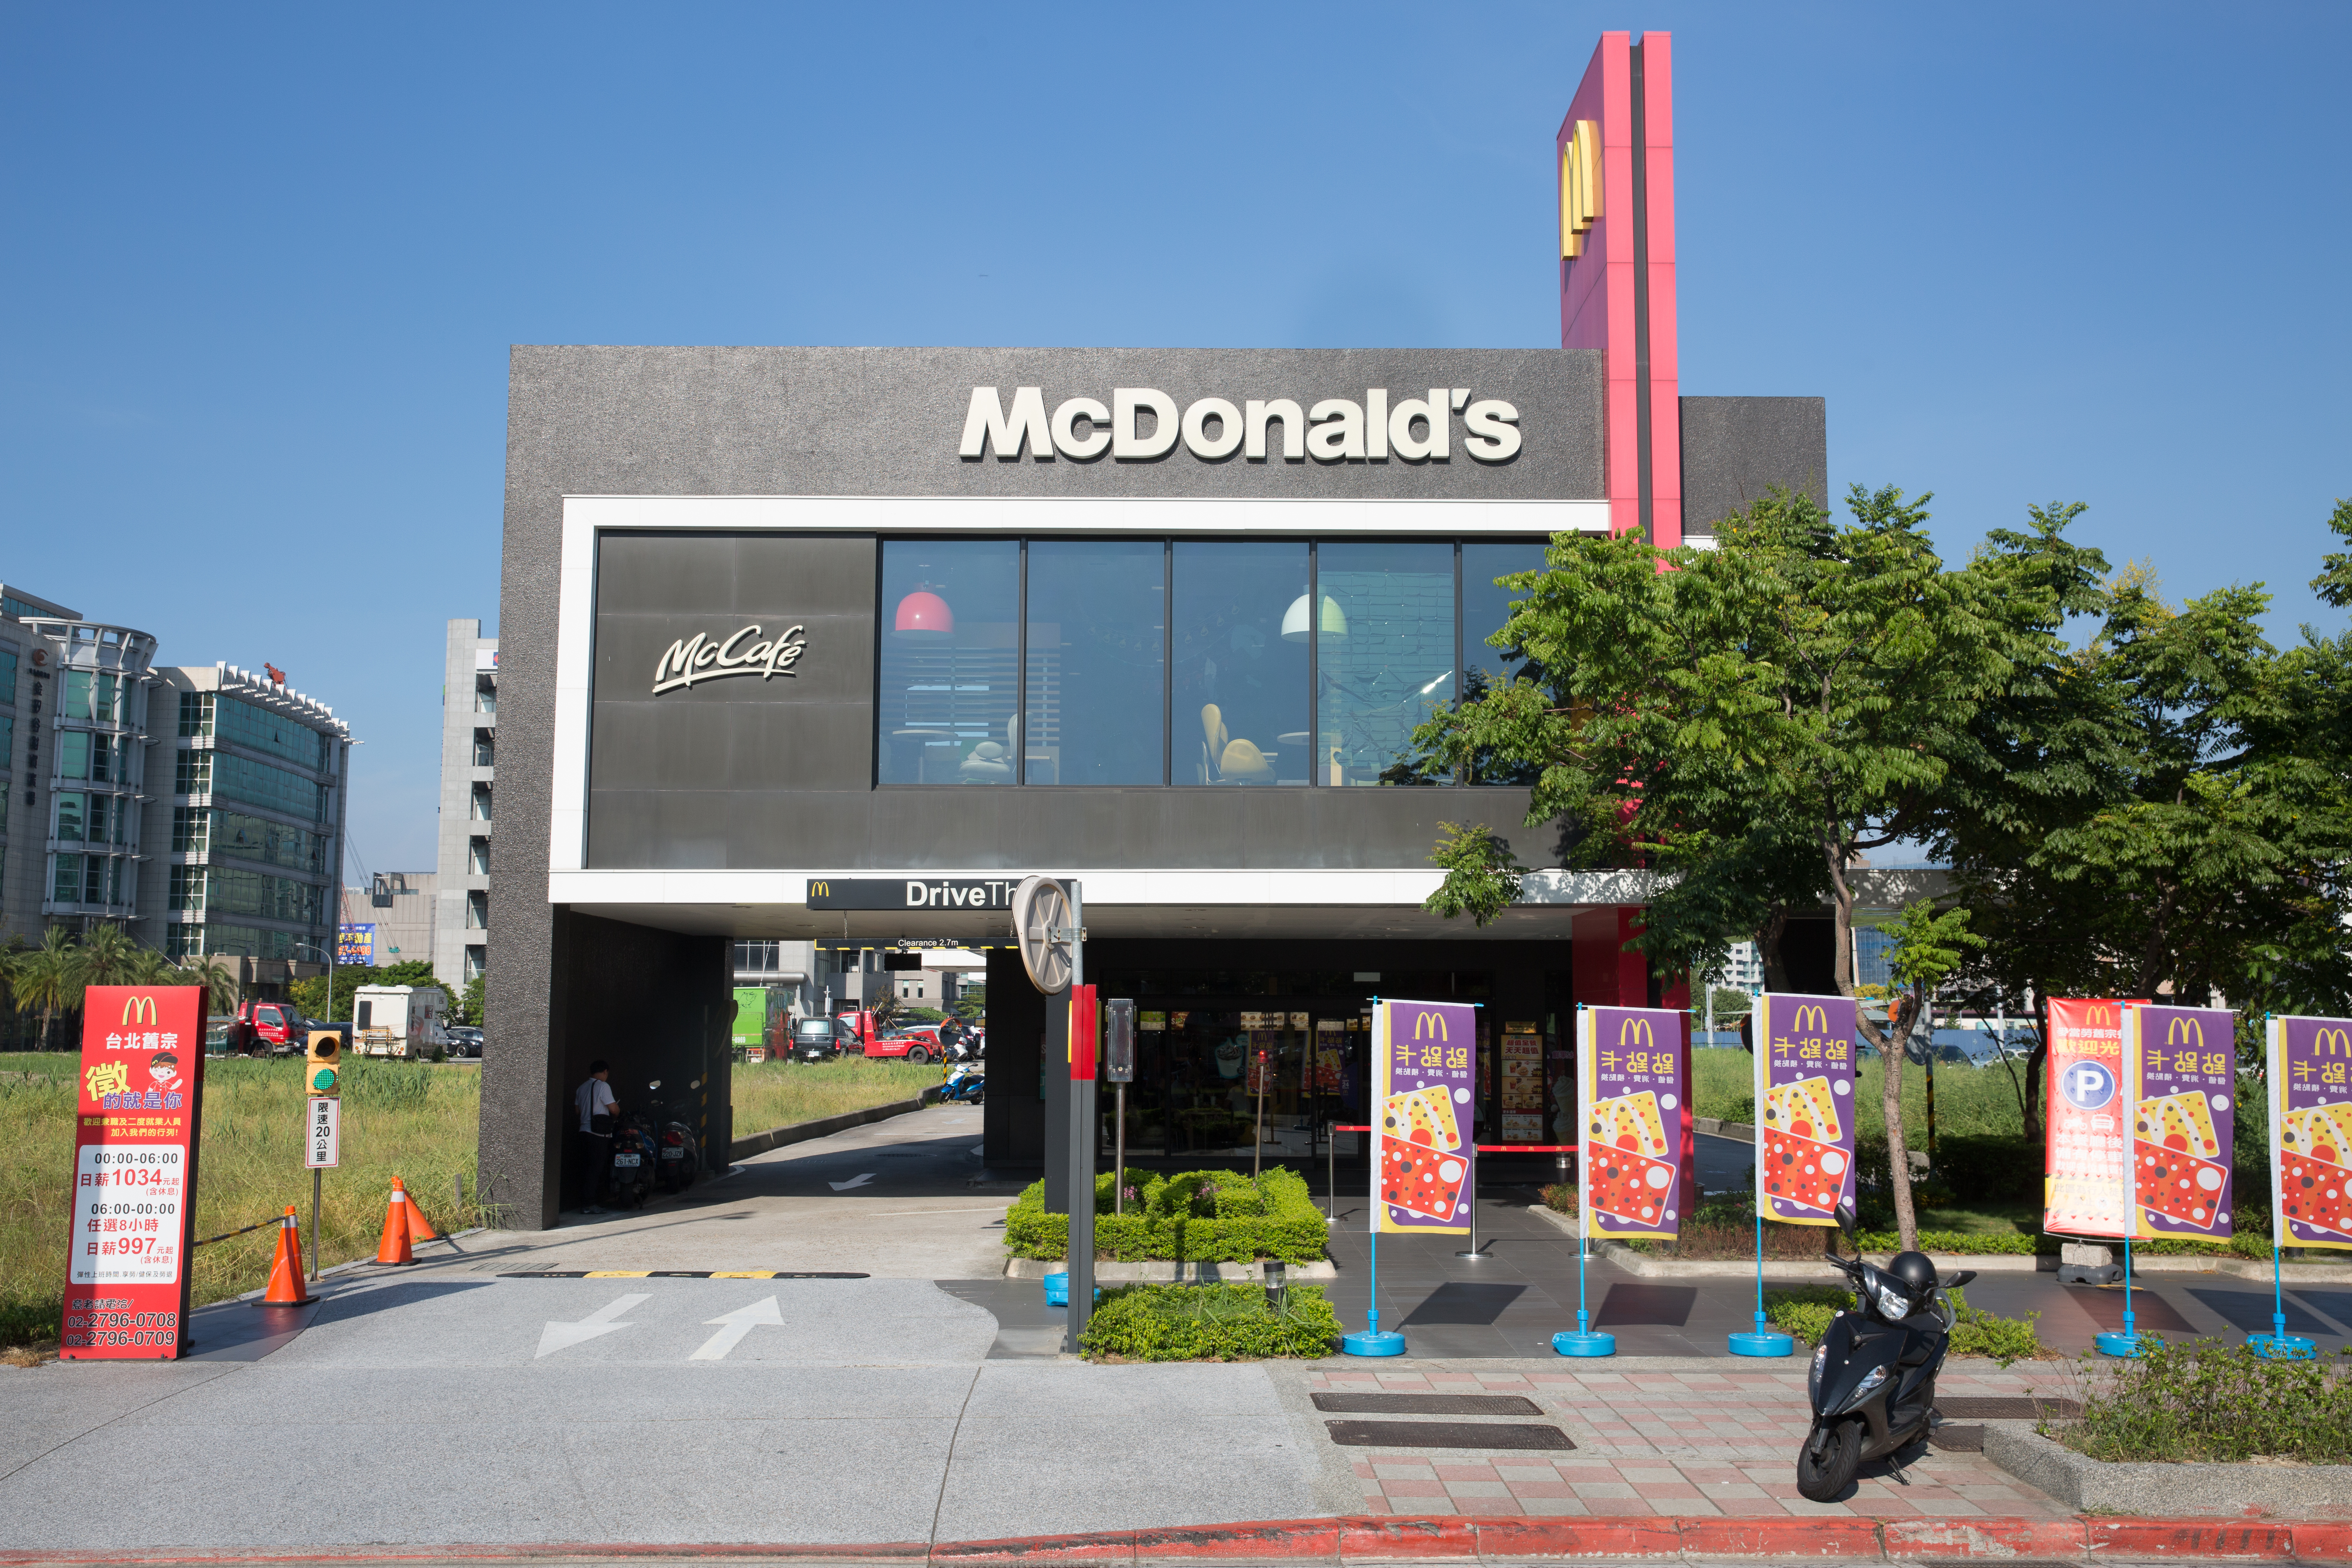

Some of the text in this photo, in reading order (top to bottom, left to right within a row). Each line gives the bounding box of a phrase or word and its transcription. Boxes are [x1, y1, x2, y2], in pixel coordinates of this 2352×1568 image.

[960, 385, 1521, 462] McDonald's
[653, 625, 805, 690] McCafé
[898, 938, 958, 947] Clearance 2.7m
[106, 1033, 178, 1050] 台北舊宗
[85, 1060, 131, 1102] 徵
[103, 1091, 183, 1110] 的就是你
[83, 1118, 181, 1126] 歡迎兼職及二度就業人員
[111, 1128, 178, 1136] 加入我們的行列!
[316, 1102, 330, 1162] 限速20公里
[2055, 1133, 2123, 1149] 本餐廳後
[95, 1153, 178, 1164] 00:00-06:00
[2055, 1147, 2123, 1163] 備有停車
[146, 1188, 178, 1196] (含休息)
[91, 1203, 175, 1214] 06:00-00:00
[87, 1218, 159, 1232] 任選8小時
[140, 1256, 173, 1265] (含休息)
[68, 1312, 176, 1328] 02-2796-0708
[67, 1330, 175, 1346] 02-2796-0709
